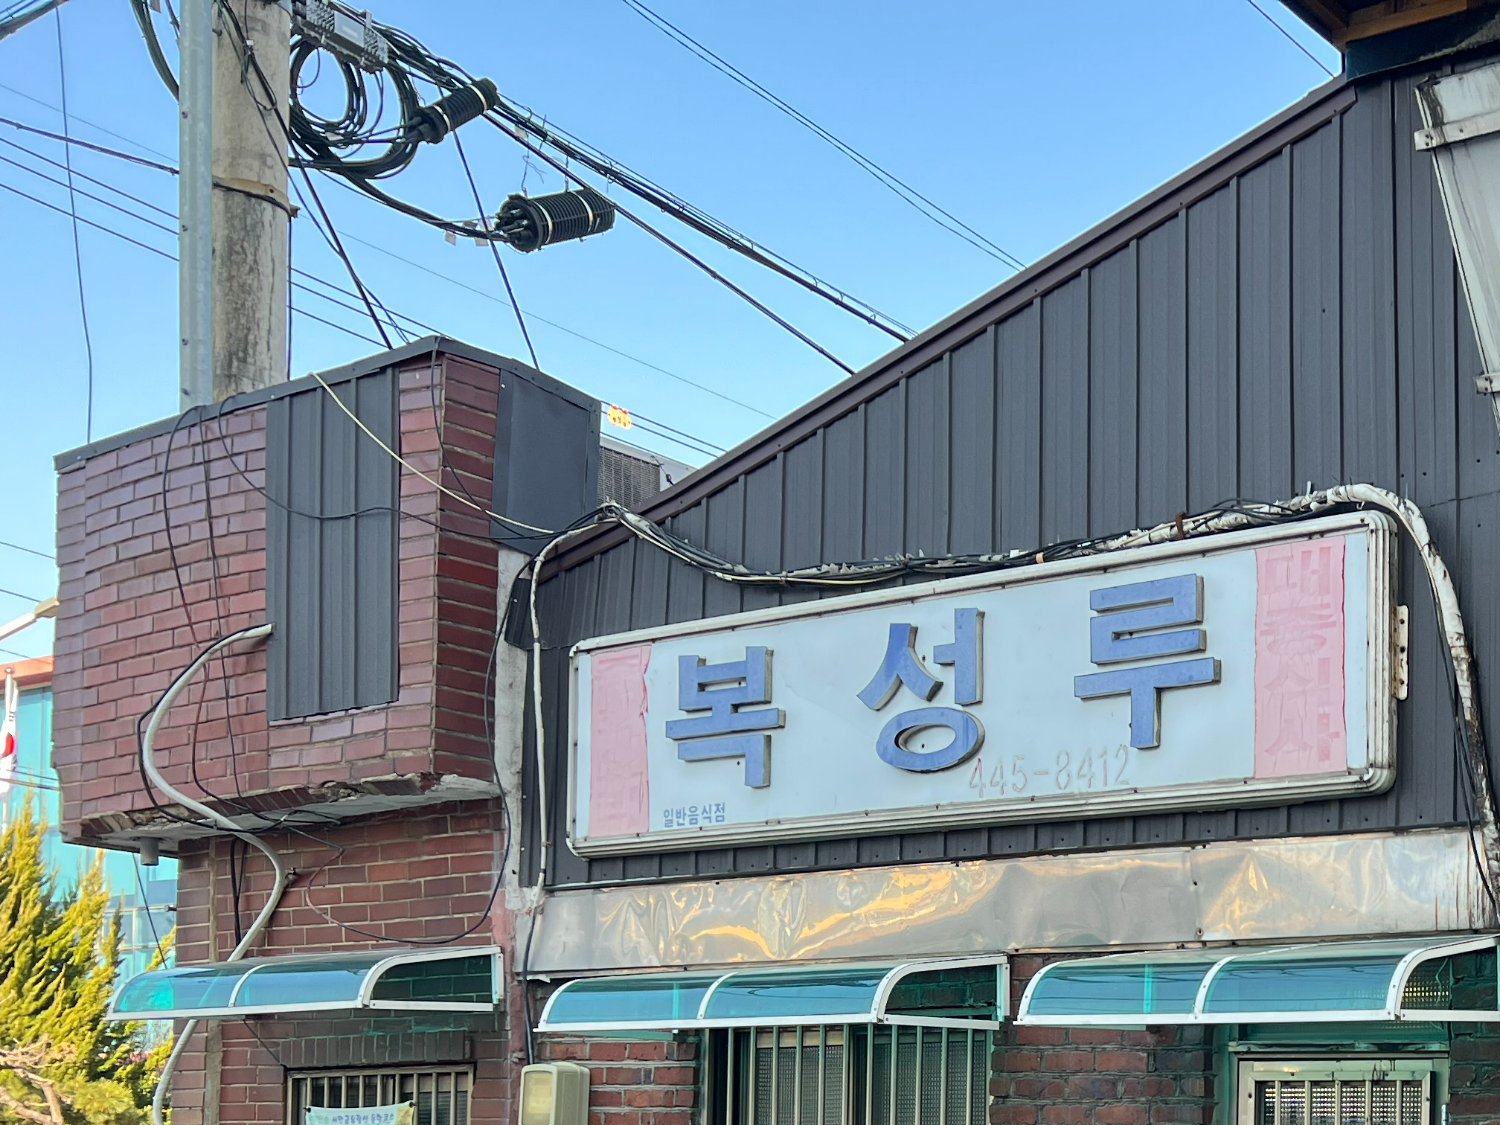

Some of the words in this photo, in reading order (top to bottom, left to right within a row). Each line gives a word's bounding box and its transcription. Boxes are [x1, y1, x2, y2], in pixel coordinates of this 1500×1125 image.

[665, 573, 1222, 789] 복성루
[968, 743, 1131, 799] 445-8412
[663, 802, 726, 828] 일반음식점
